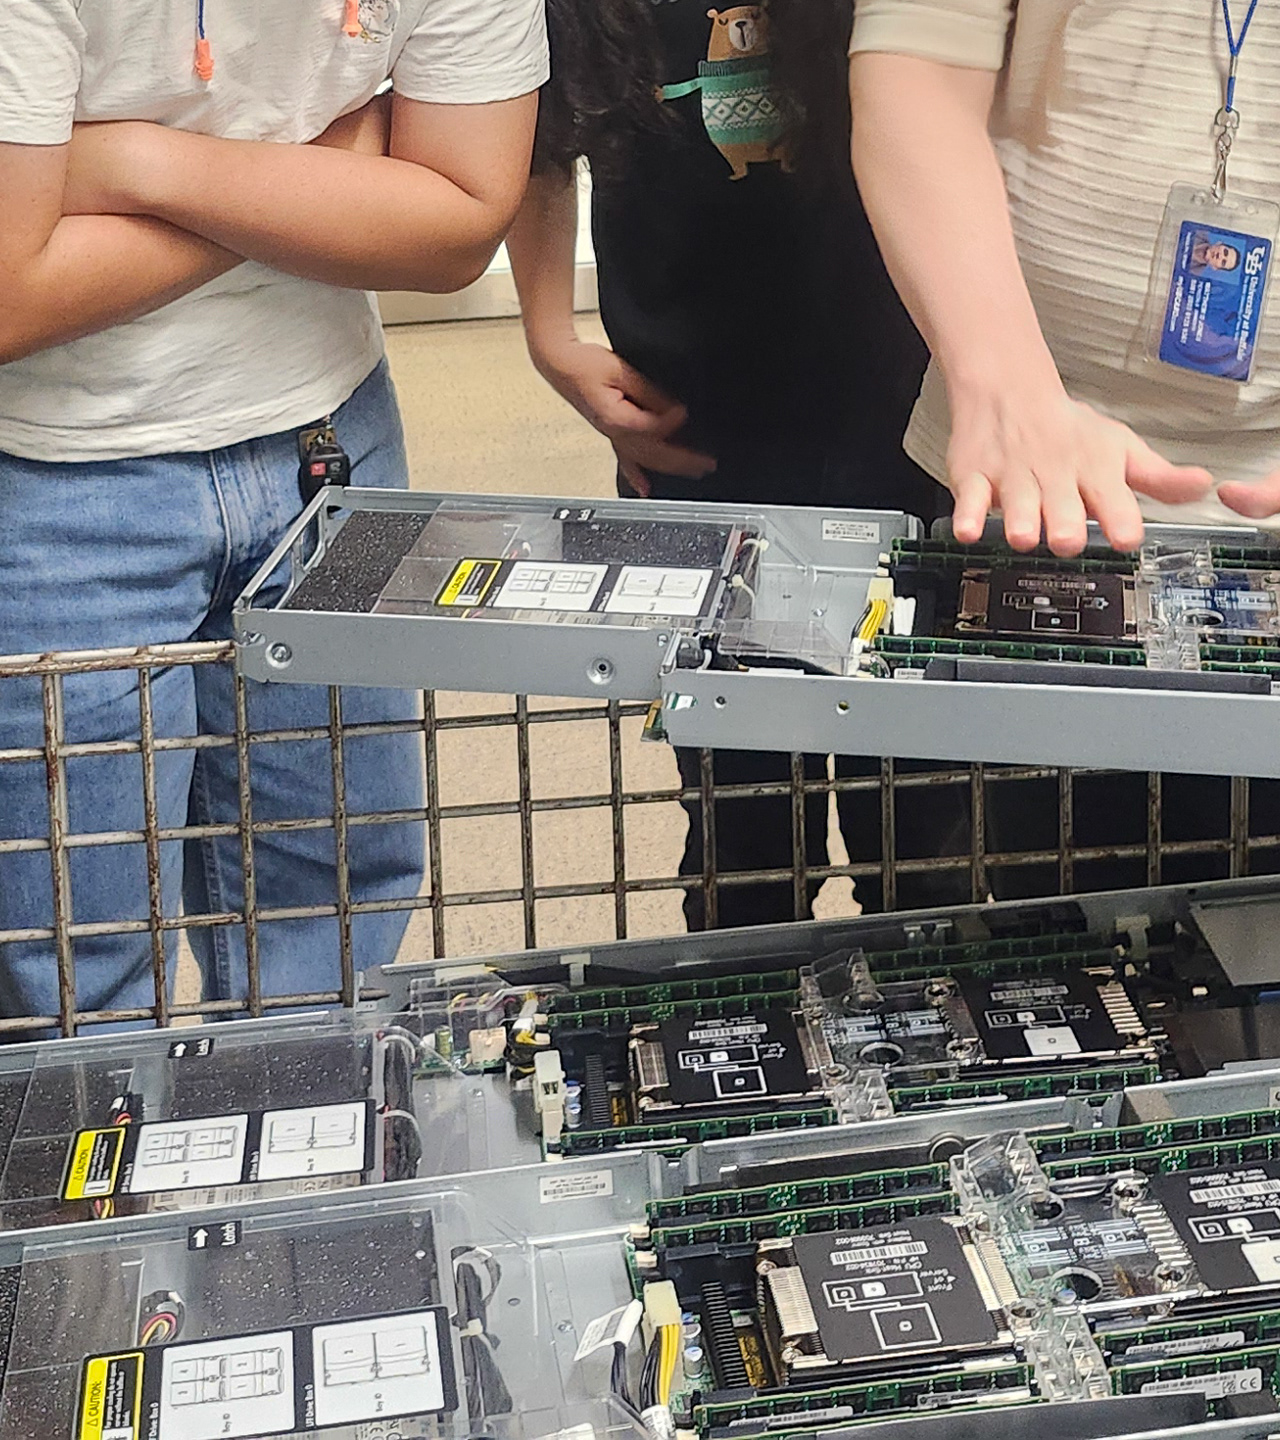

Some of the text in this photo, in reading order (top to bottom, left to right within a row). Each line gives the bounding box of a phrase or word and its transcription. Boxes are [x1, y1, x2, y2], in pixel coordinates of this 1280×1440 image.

[1241, 276, 1259, 320] University
[221, 1222, 236, 1246] Latch
[1240, 1377, 1257, 1390] CE
